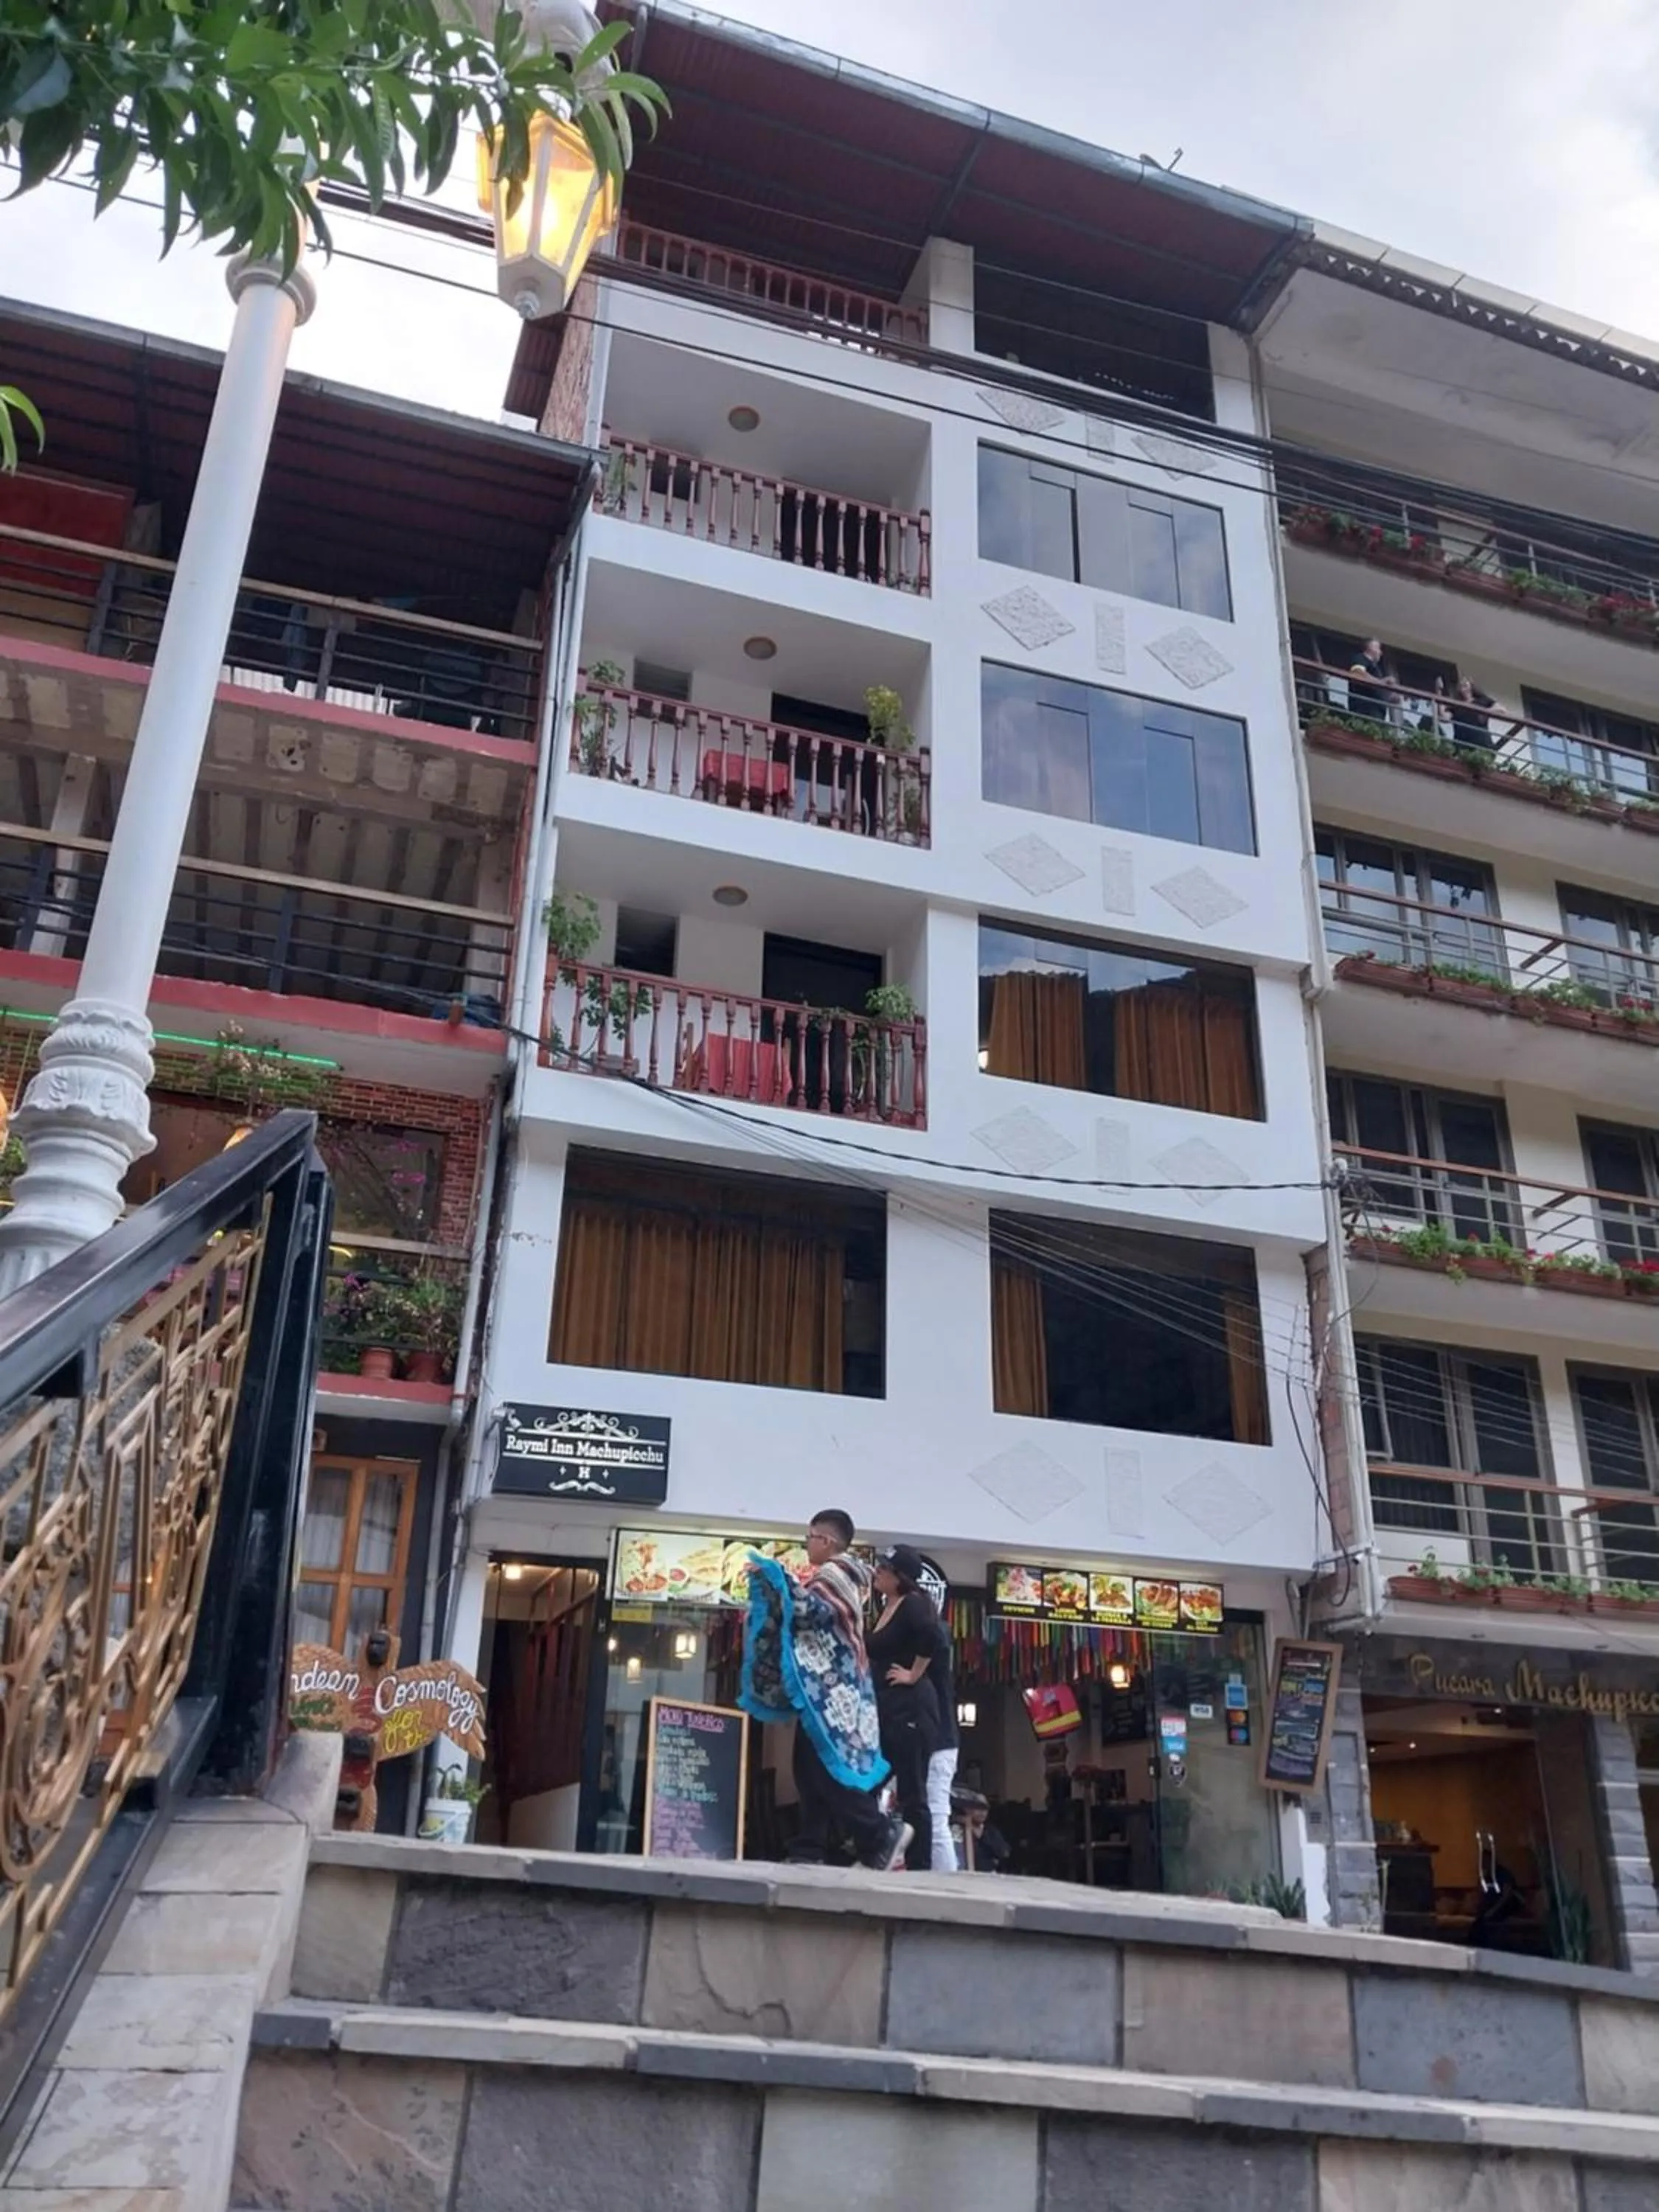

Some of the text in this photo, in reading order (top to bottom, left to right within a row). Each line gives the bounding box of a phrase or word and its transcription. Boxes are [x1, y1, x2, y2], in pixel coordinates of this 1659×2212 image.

[505, 1435, 664, 1463] Raymi Inn Machupicchu
[577, 1466, 591, 1478] H
[375, 1671, 479, 1735] Cosmology
